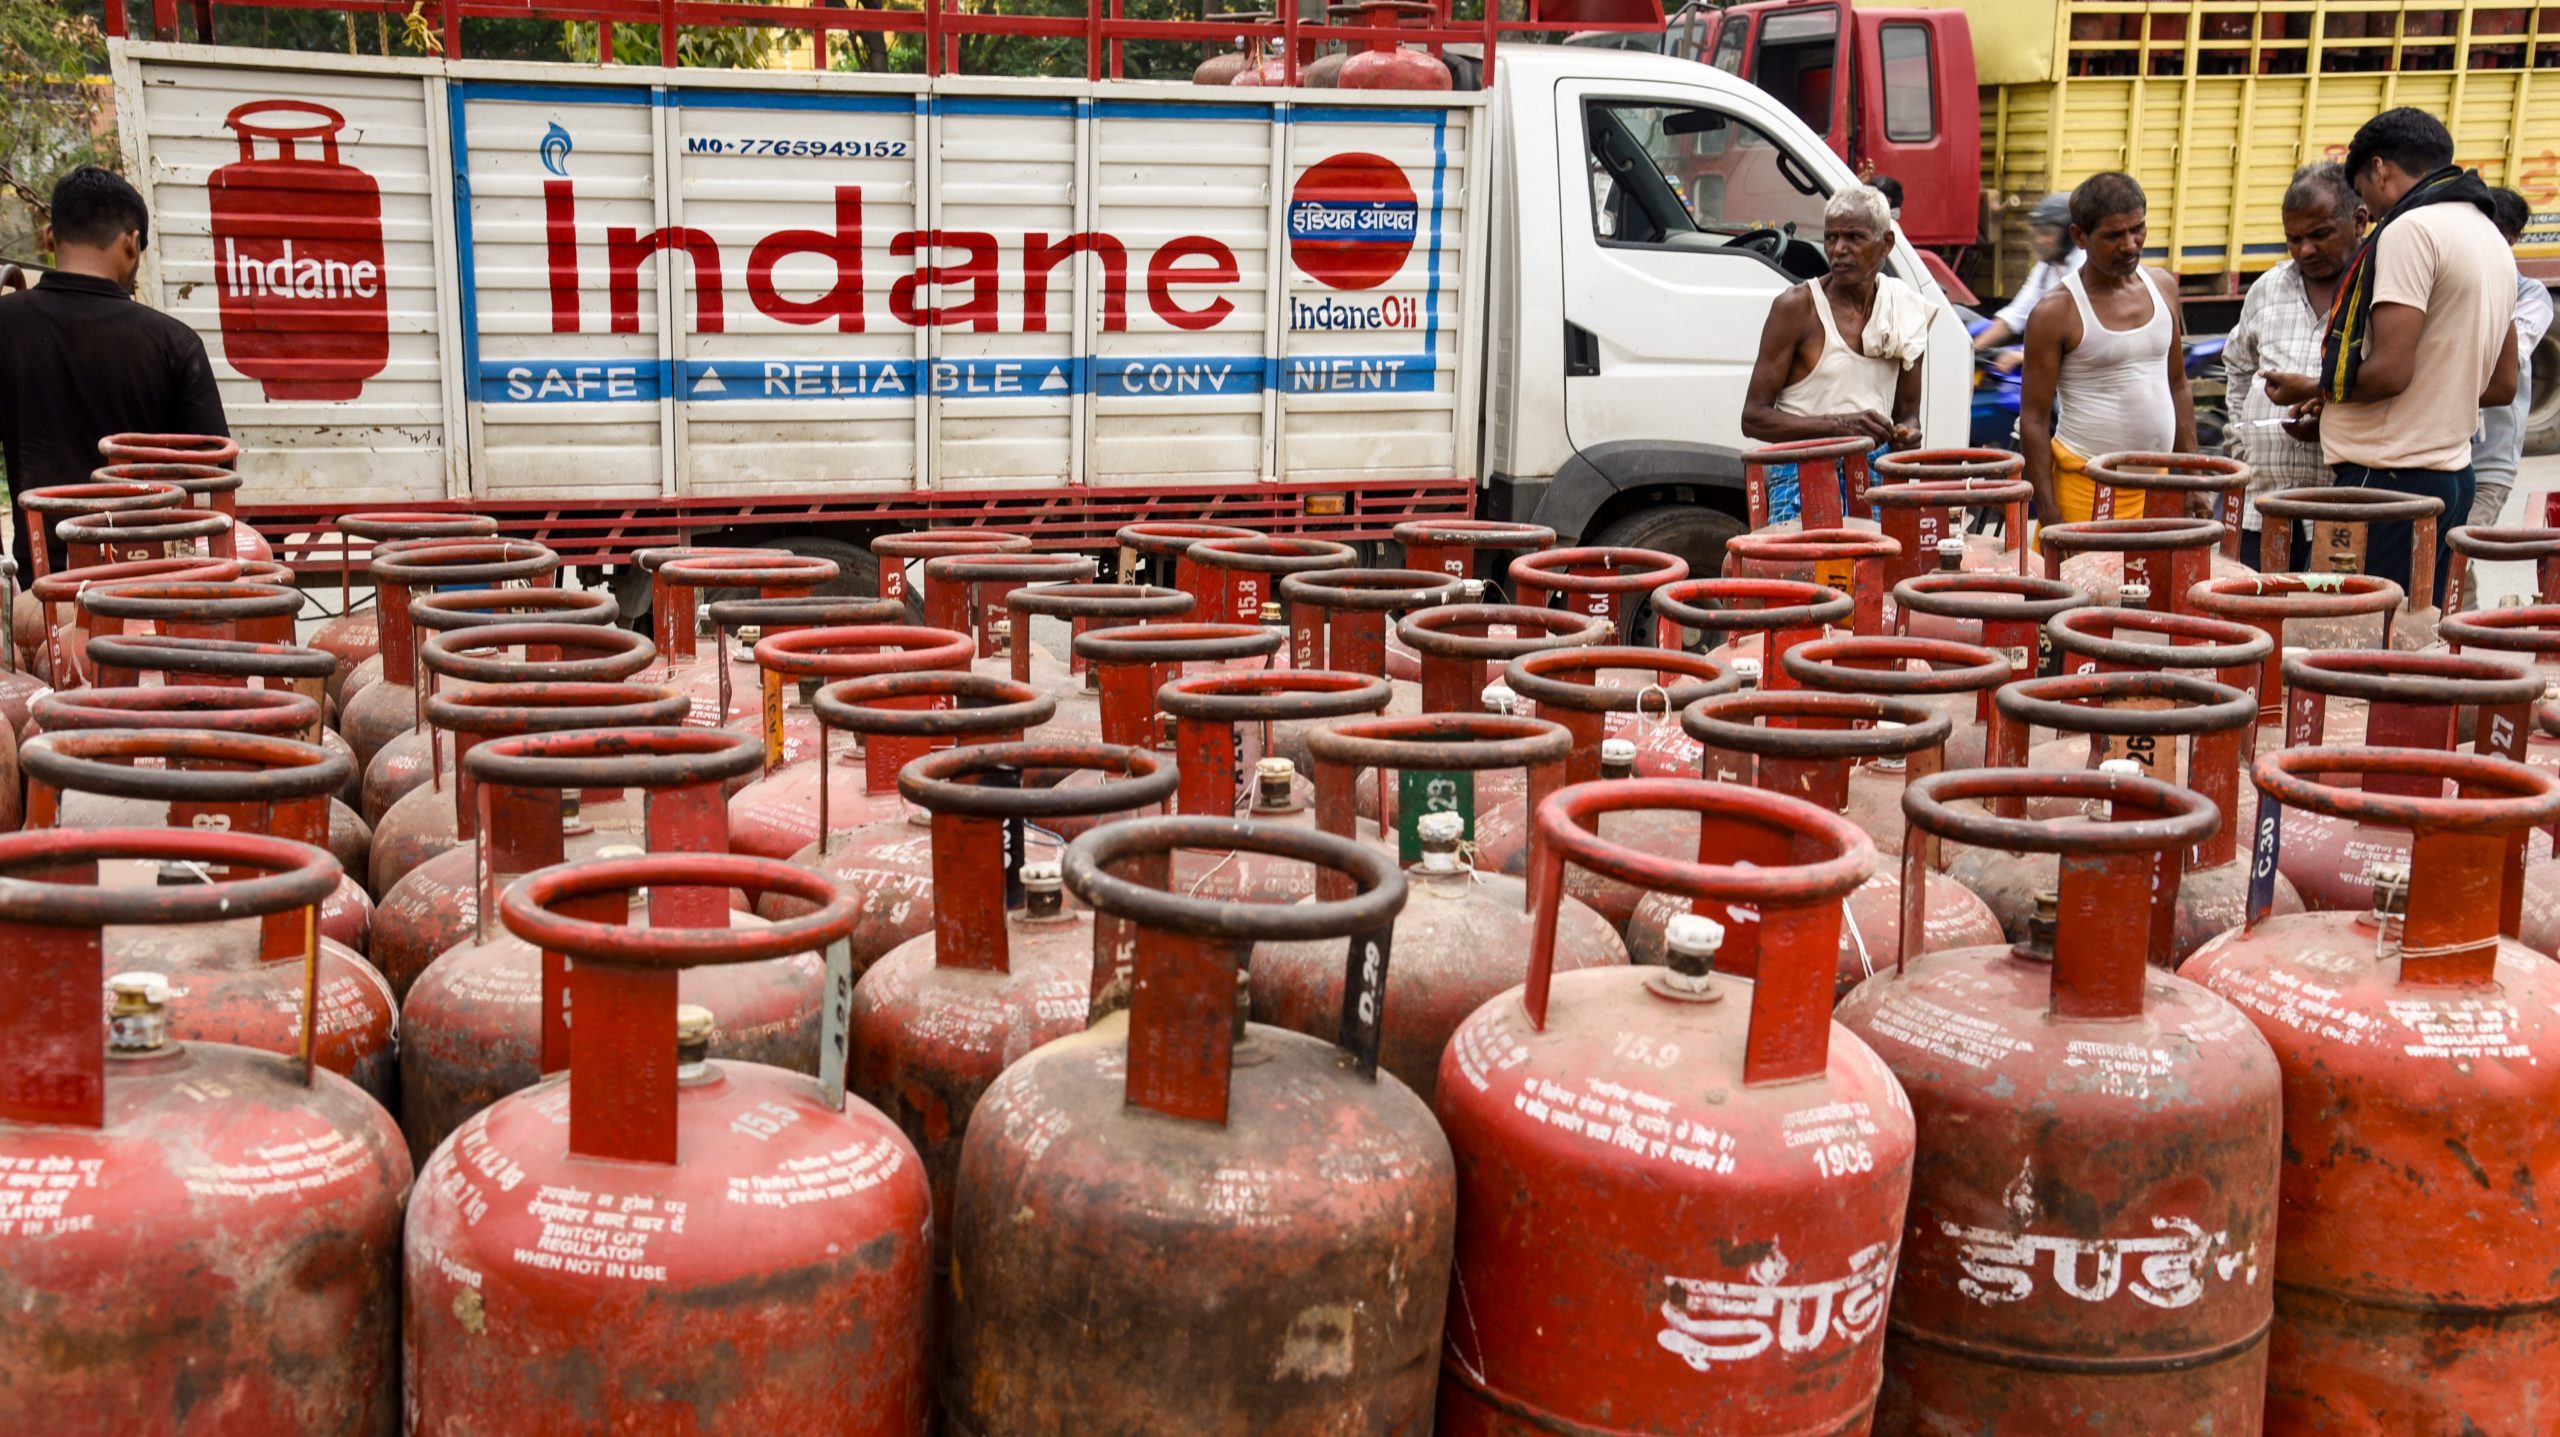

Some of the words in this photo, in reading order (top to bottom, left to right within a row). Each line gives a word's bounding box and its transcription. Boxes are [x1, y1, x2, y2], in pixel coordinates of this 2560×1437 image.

[1292, 202, 1357, 233] इंडियन
[1358, 202, 1416, 231] ऑयल
[224, 237, 378, 300] Indane
[543, 180, 1240, 334] Indane
[507, 366, 639, 401] SAFE
[2223, 495, 2238, 533] 15.5
[1236, 580, 1256, 619] 15.8
[2126, 735, 2156, 767] 26
[1358, 941, 1380, 1026] D.29
[729, 1100, 801, 1142] 15.5
[1812, 1139, 1875, 1179] 1906
[30, 1189, 71, 1206] OFF
[53, 1214, 95, 1235] USE
[612, 1231, 649, 1248] OFF
[513, 1247, 563, 1271] WHEN
[564, 1257, 603, 1276] NOT
[605, 1262, 626, 1279] IN
[629, 1265, 668, 1282] USE
[537, 1235, 645, 1264] REGULATOR
